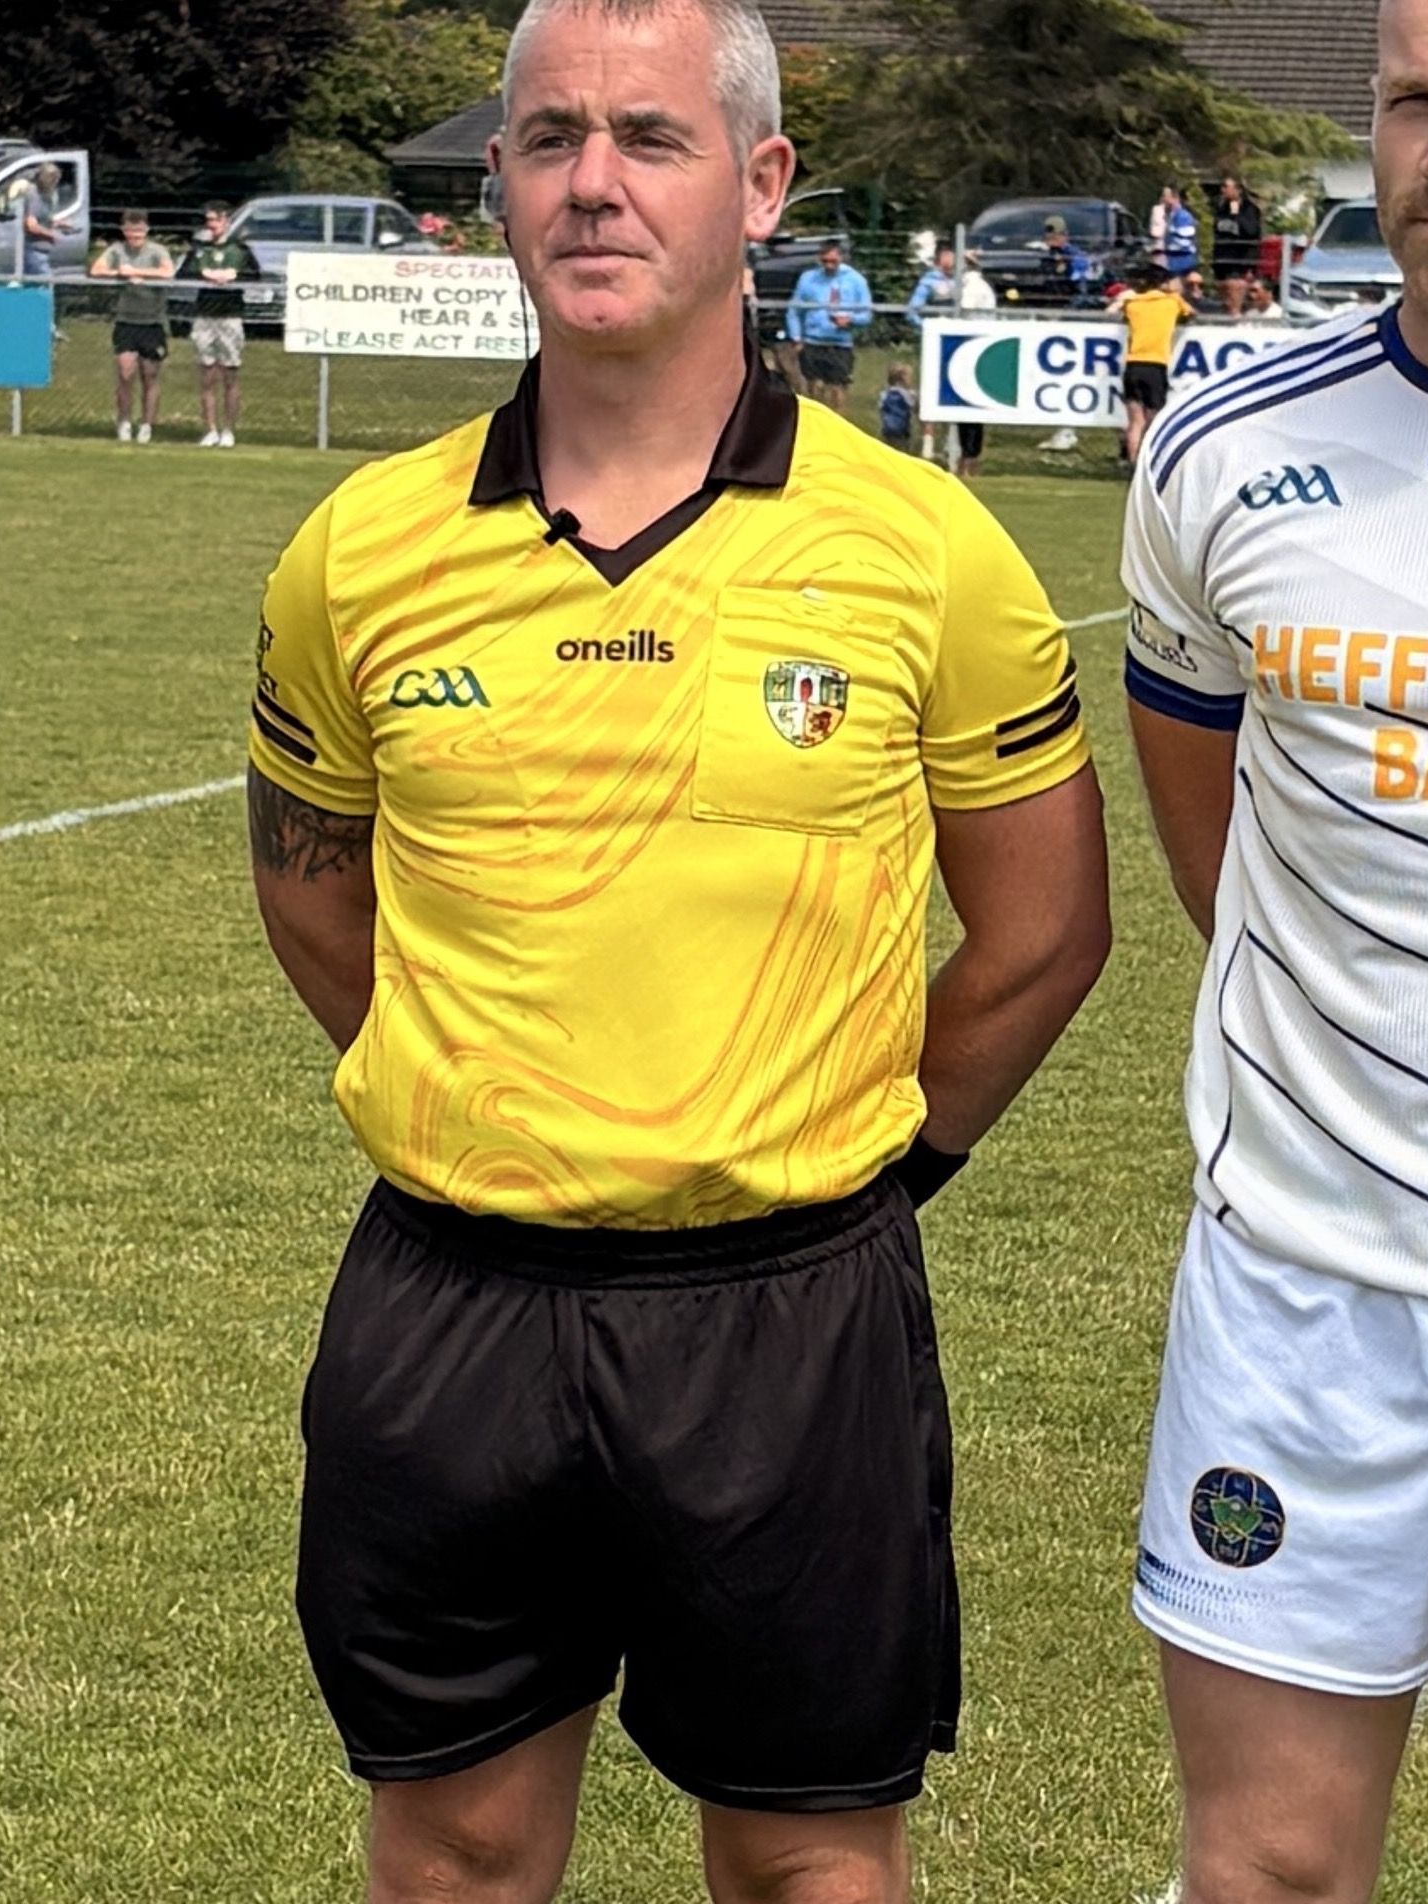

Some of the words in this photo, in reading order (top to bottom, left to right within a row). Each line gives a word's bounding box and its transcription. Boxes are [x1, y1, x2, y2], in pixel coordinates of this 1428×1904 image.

[295, 283, 422, 304] CHILDREN
[434, 288, 507, 306] COPY
[400, 309, 470, 327] HEAR
[481, 312, 498, 328] &
[305, 327, 404, 350] PLEASE
[414, 335, 463, 350] ACT
[475, 336, 537, 354] RES
